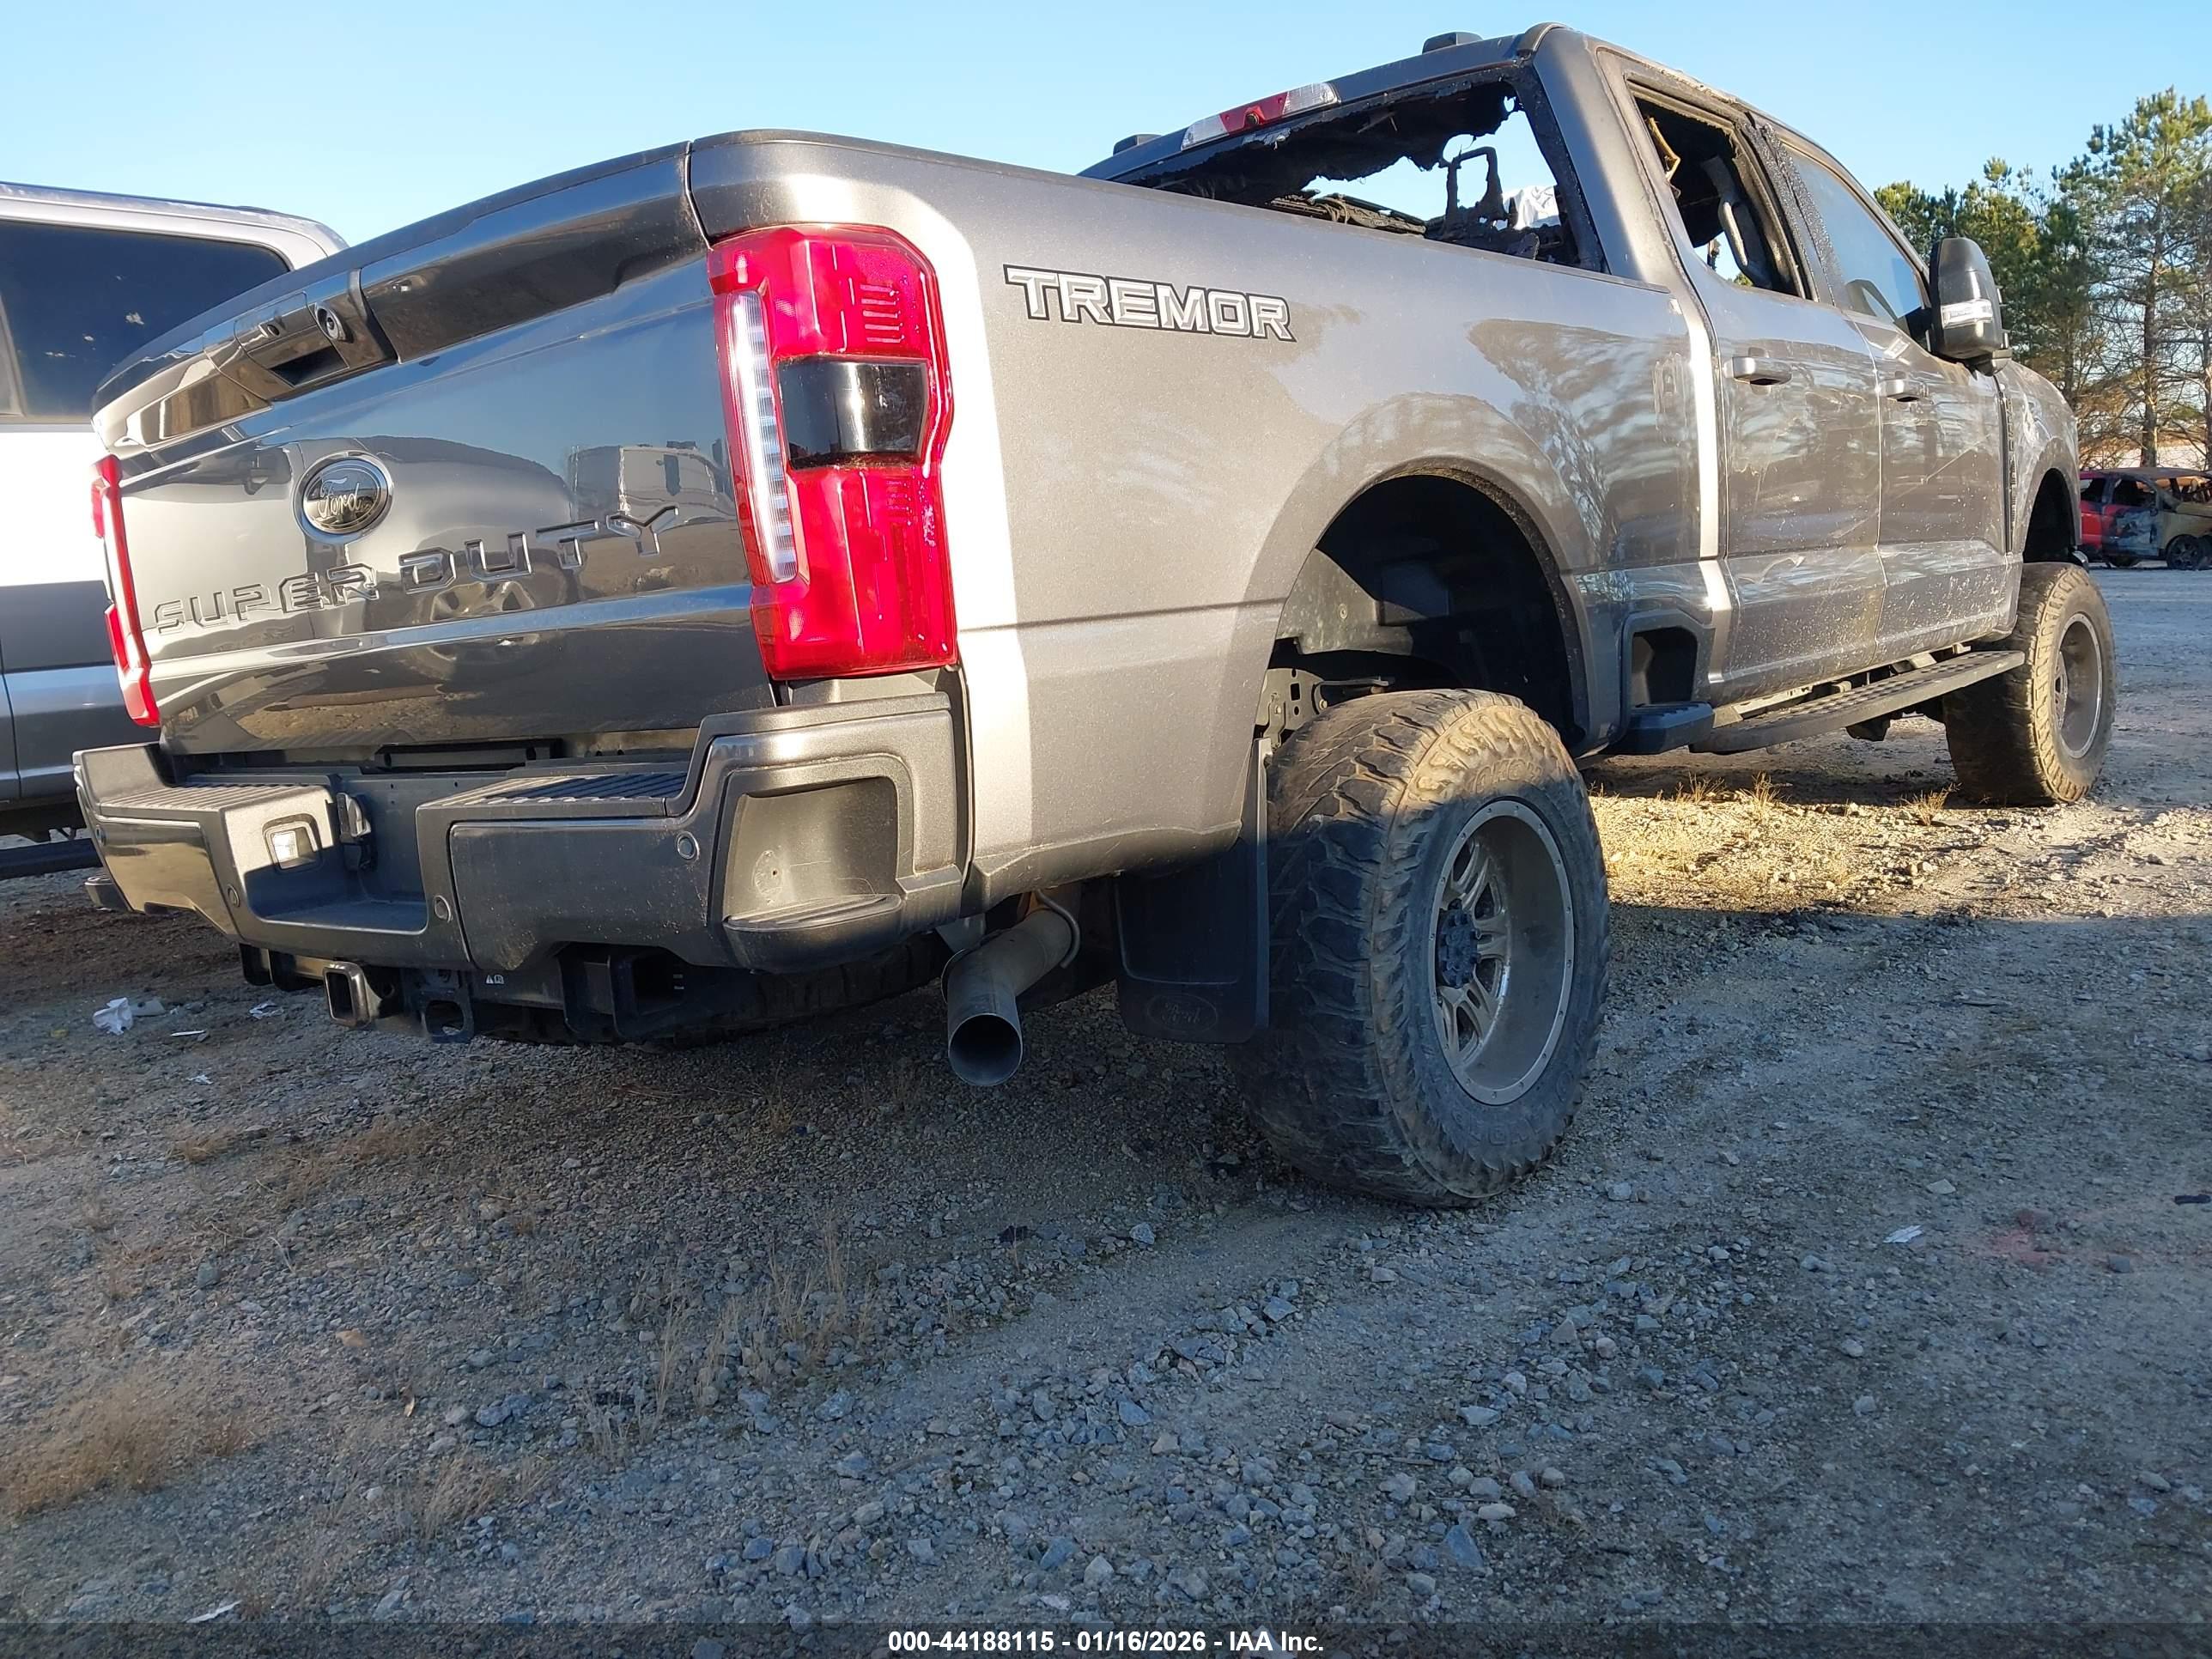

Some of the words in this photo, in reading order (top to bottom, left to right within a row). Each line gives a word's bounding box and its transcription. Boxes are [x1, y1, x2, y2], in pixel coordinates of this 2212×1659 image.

[1003, 264, 1297, 343] TREMOR
[317, 477, 362, 520] Ford
[154, 562, 380, 635] SUPER
[398, 505, 681, 593] DUTY
